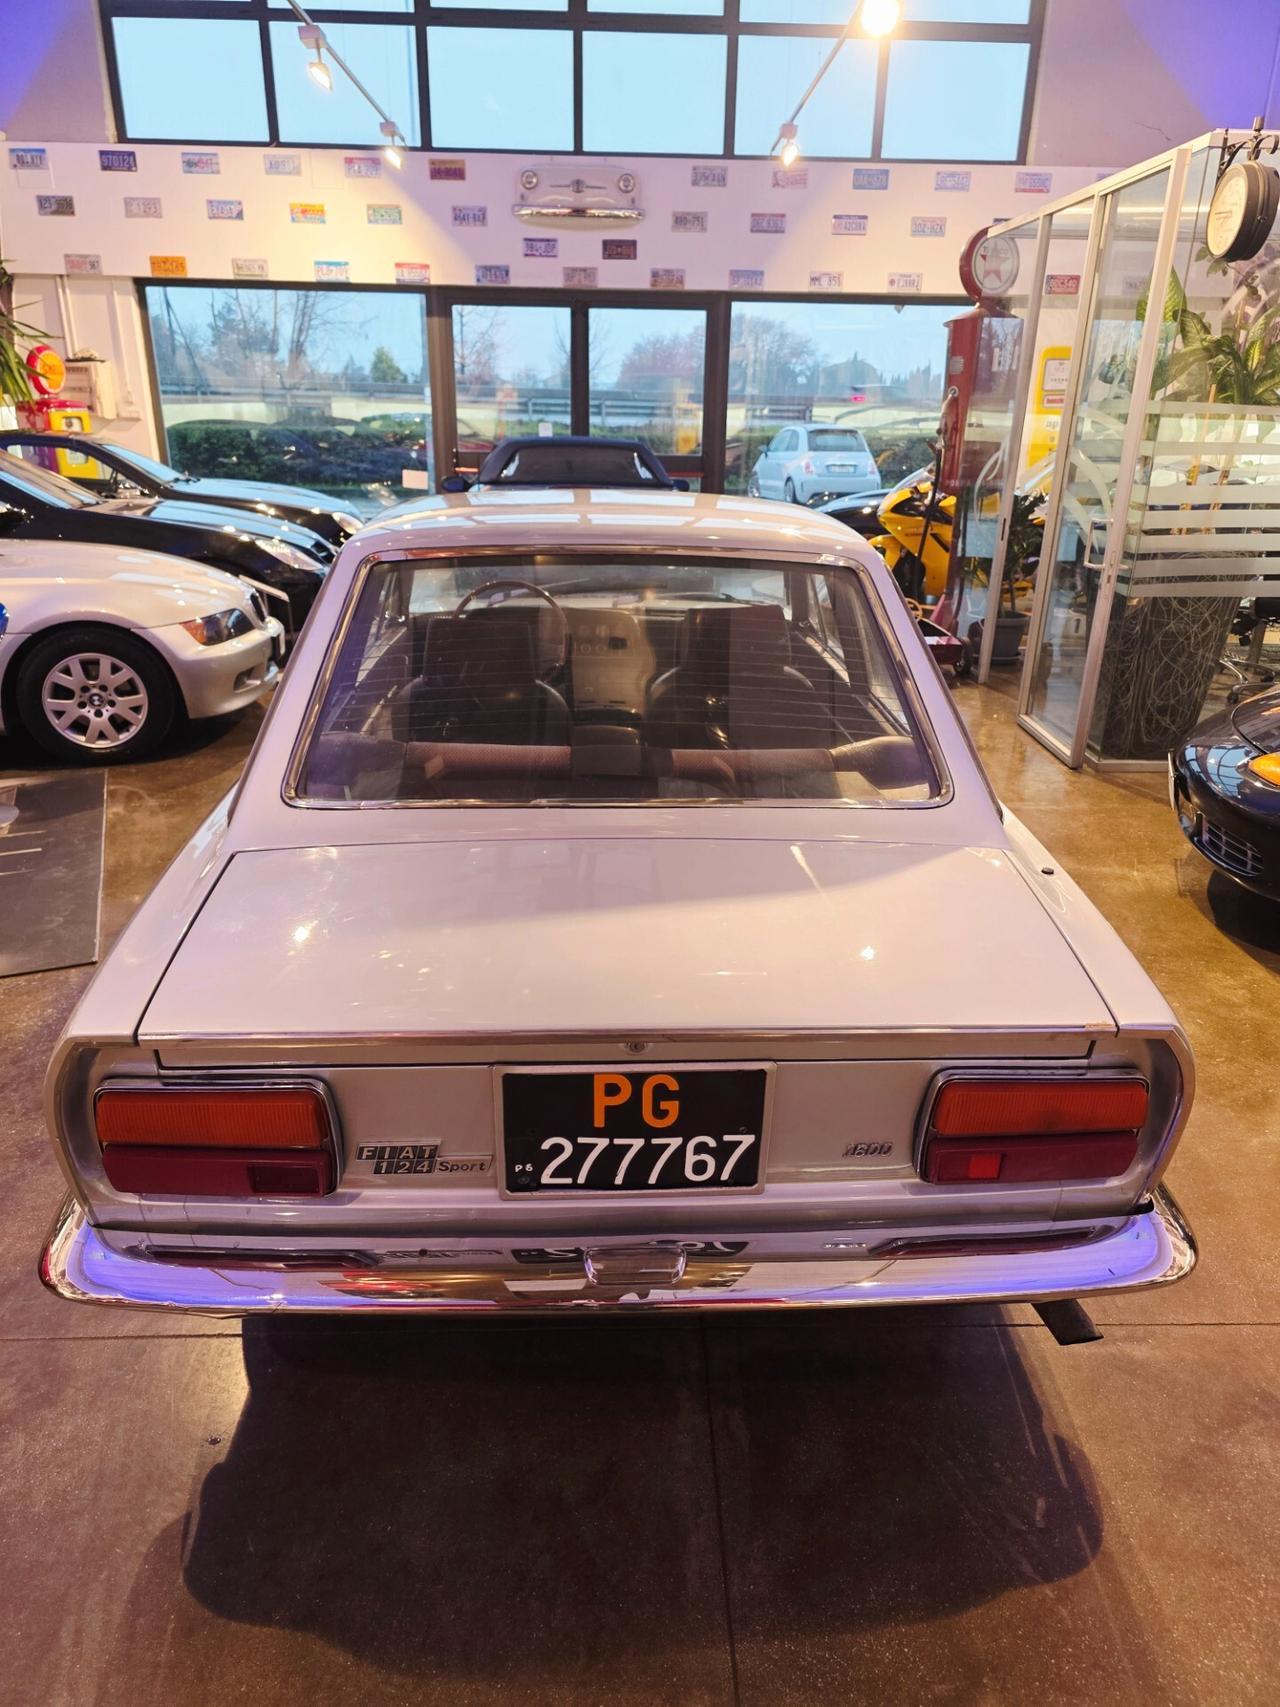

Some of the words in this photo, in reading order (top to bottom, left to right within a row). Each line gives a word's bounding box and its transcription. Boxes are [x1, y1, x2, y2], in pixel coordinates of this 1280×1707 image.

[593, 1072, 680, 1128] PG
[361, 1146, 436, 1160] FIAT
[379, 1161, 430, 1174] 124
[438, 1161, 486, 1173] Sport
[540, 1134, 756, 1185] 277767
